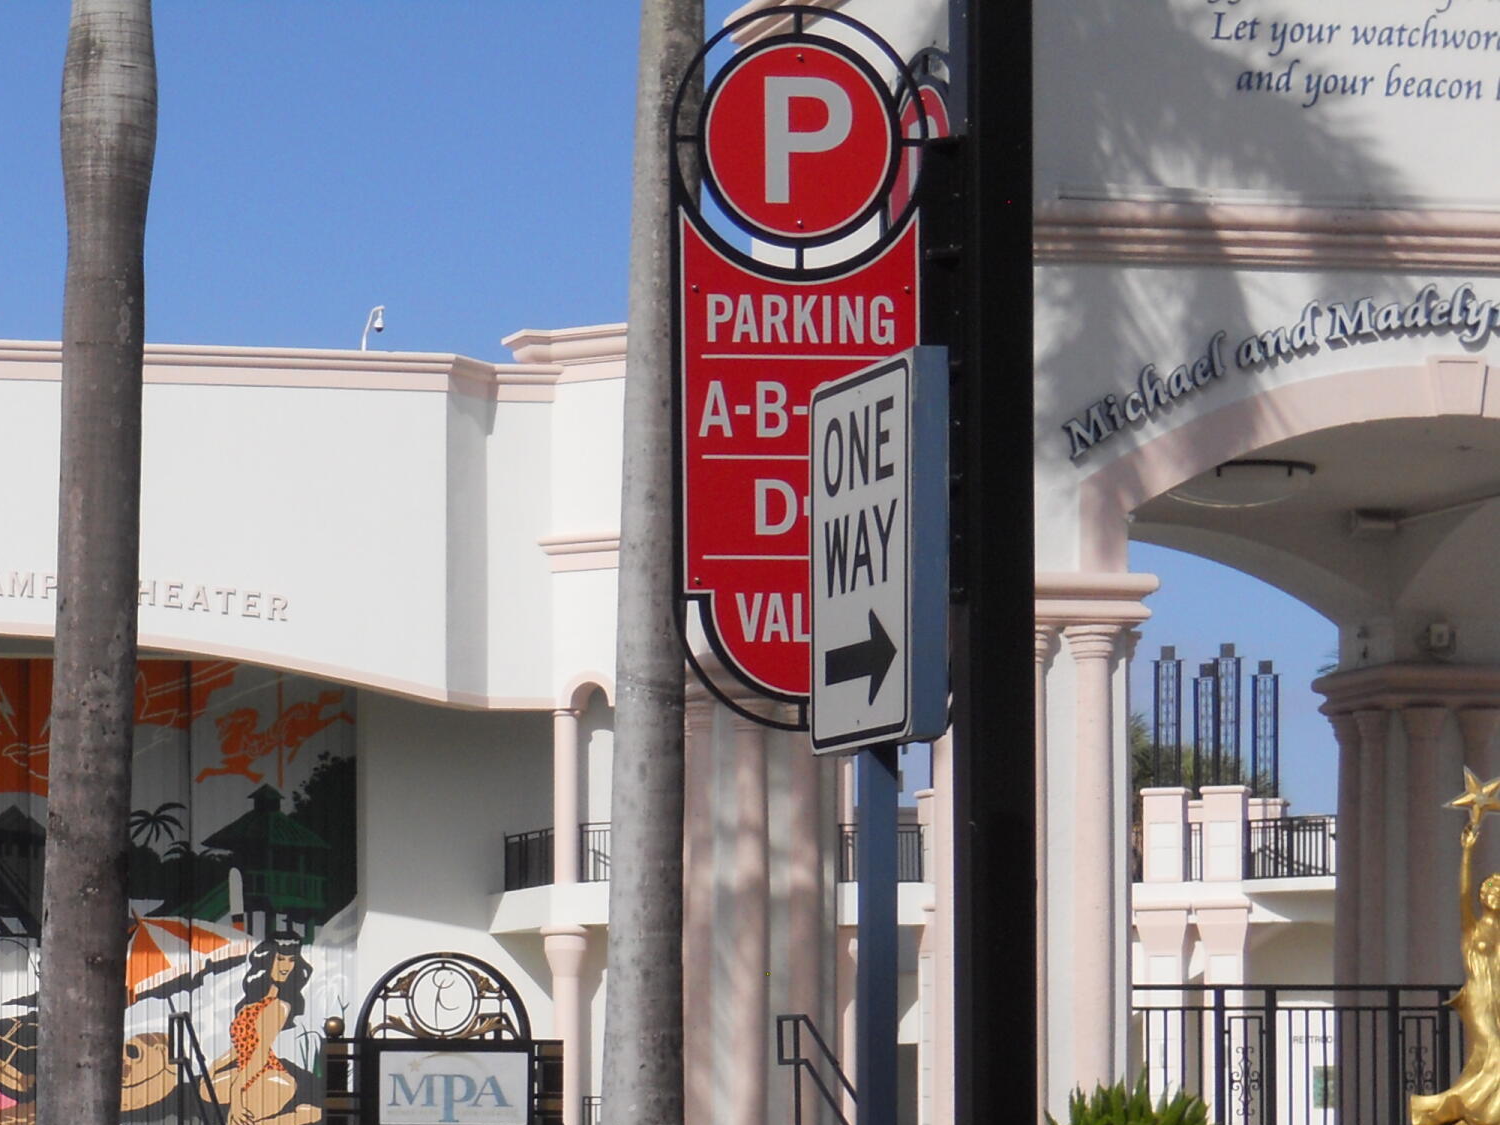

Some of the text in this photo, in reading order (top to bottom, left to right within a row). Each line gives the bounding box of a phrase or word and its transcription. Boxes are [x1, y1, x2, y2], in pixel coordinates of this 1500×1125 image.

[1211, 12, 1500, 56] Let your watchwor
[1236, 59, 1300, 92] and
[1302, 74, 1375, 108] your
[1385, 63, 1482, 99] beacon
[764, 76, 853, 204] P
[706, 293, 896, 345] PARKING
[698, 380, 820, 439] A-B-
[1062, 329, 1228, 464] Michael
[1235, 299, 1320, 370] and
[823, 395, 895, 498] ONE
[824, 498, 898, 598] WAY
[387, 1073, 514, 1123] MPA
